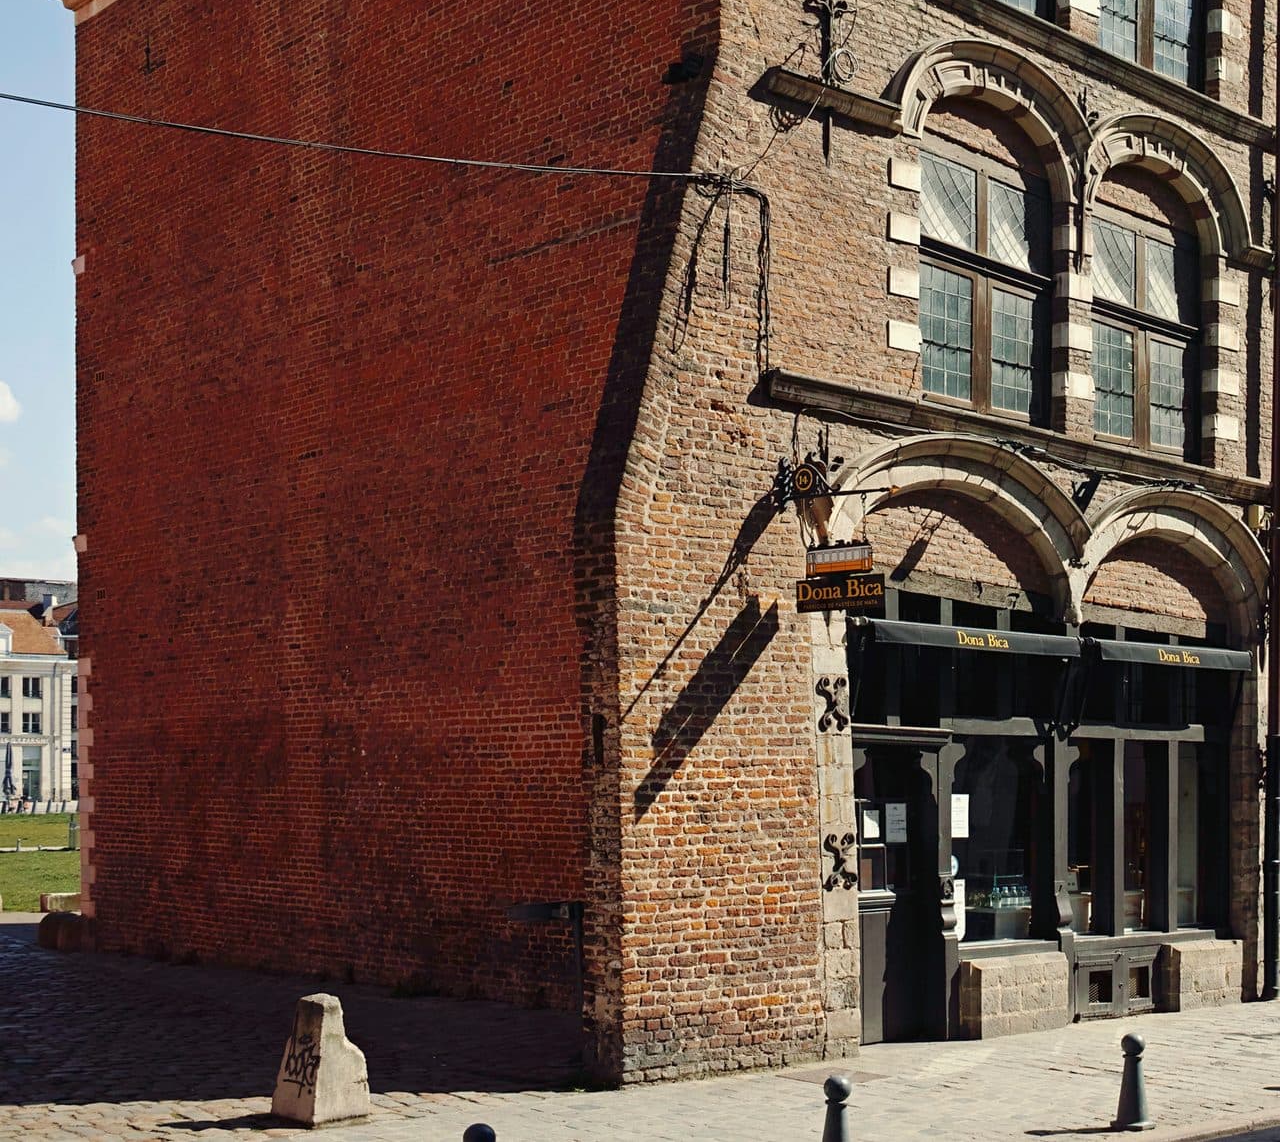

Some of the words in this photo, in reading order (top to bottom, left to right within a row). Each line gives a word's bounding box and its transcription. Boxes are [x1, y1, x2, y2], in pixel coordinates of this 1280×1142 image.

[798, 583, 842, 601] Dona
[846, 578, 883, 598] Bica
[957, 630, 984, 646] Dona
[987, 633, 1009, 648] Bica
[1158, 648, 1180, 663] Dona
[1182, 651, 1200, 664] Bica
